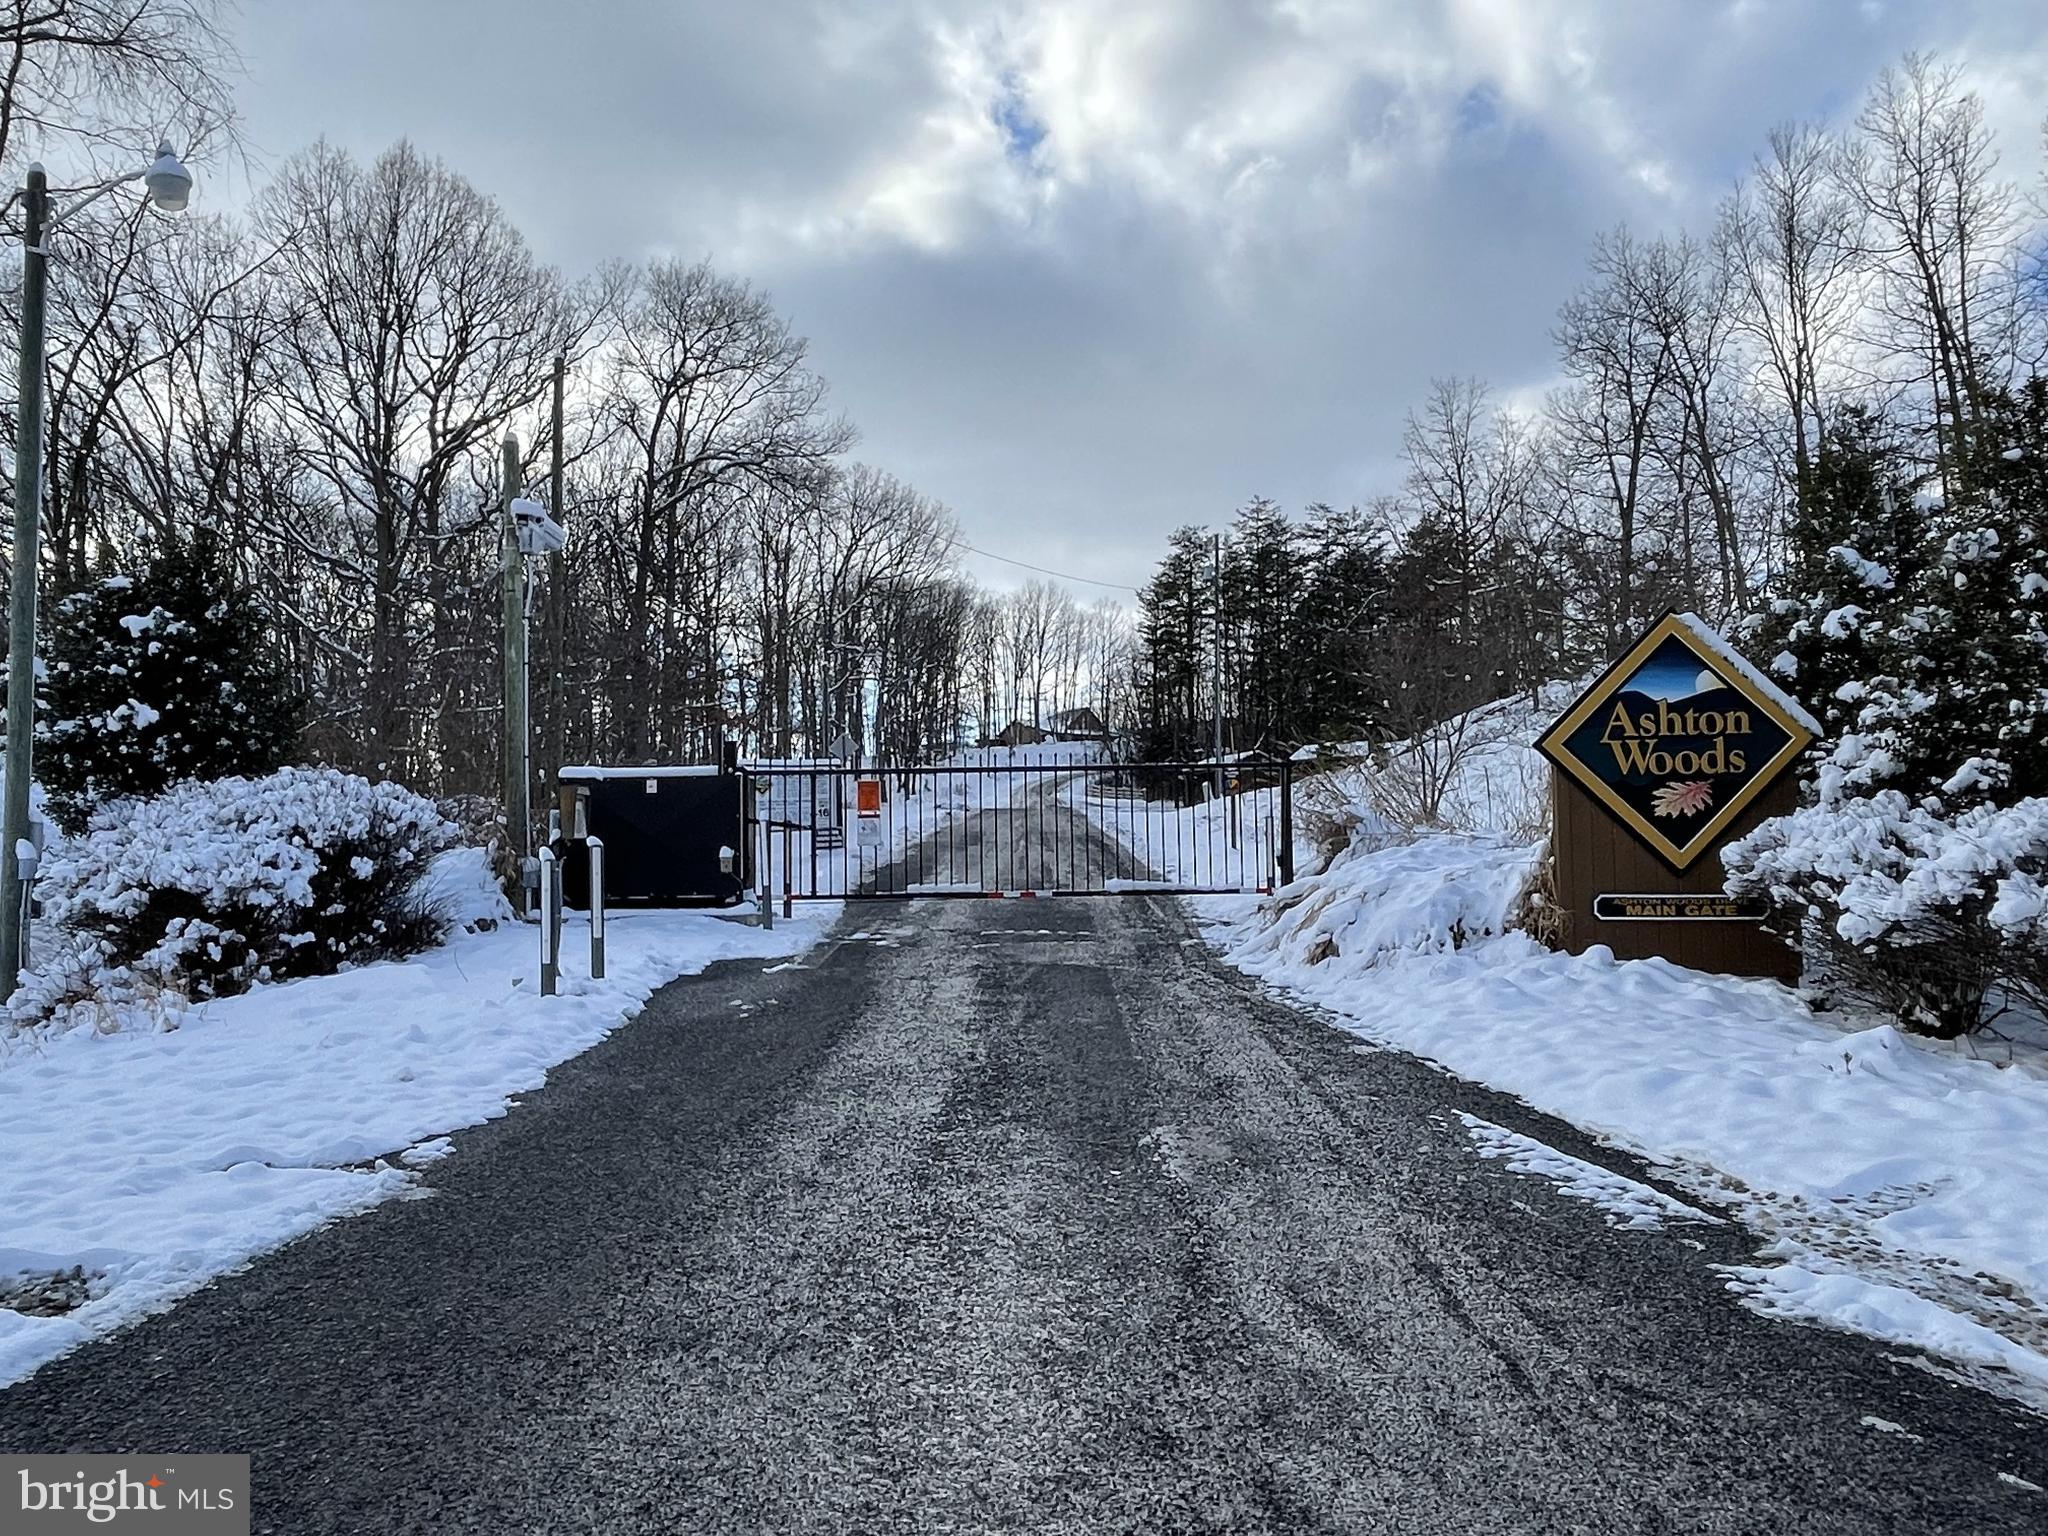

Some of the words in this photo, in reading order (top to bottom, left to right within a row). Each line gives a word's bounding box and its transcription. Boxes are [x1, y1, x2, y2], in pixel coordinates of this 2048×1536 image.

[1600, 698, 1752, 743] Ashton
[1610, 736, 1747, 776] Woods
[1626, 905, 1676, 916] MAIN
[1684, 905, 1738, 916] GATE
